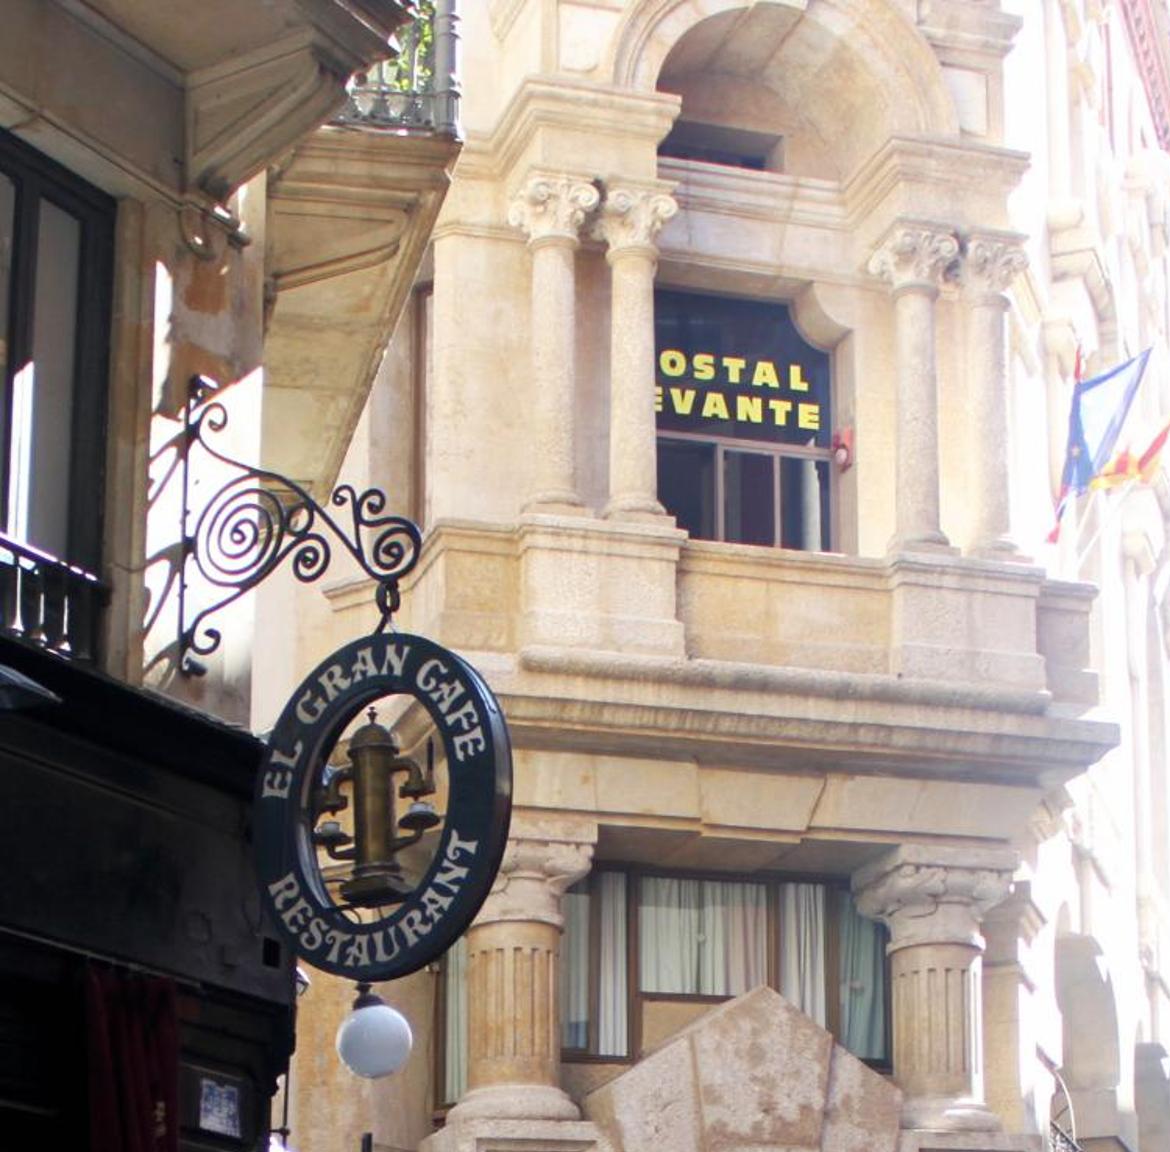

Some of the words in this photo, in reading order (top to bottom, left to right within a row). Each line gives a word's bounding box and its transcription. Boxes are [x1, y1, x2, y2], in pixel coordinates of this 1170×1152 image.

[655, 386, 820, 430] VANTE
[659, 349, 809, 392] OSTAL
[263, 740, 304, 800] EL
[296, 643, 411, 726] GRAN
[416, 658, 486, 763] CAFE
[268, 829, 479, 967] RESTAURANT
